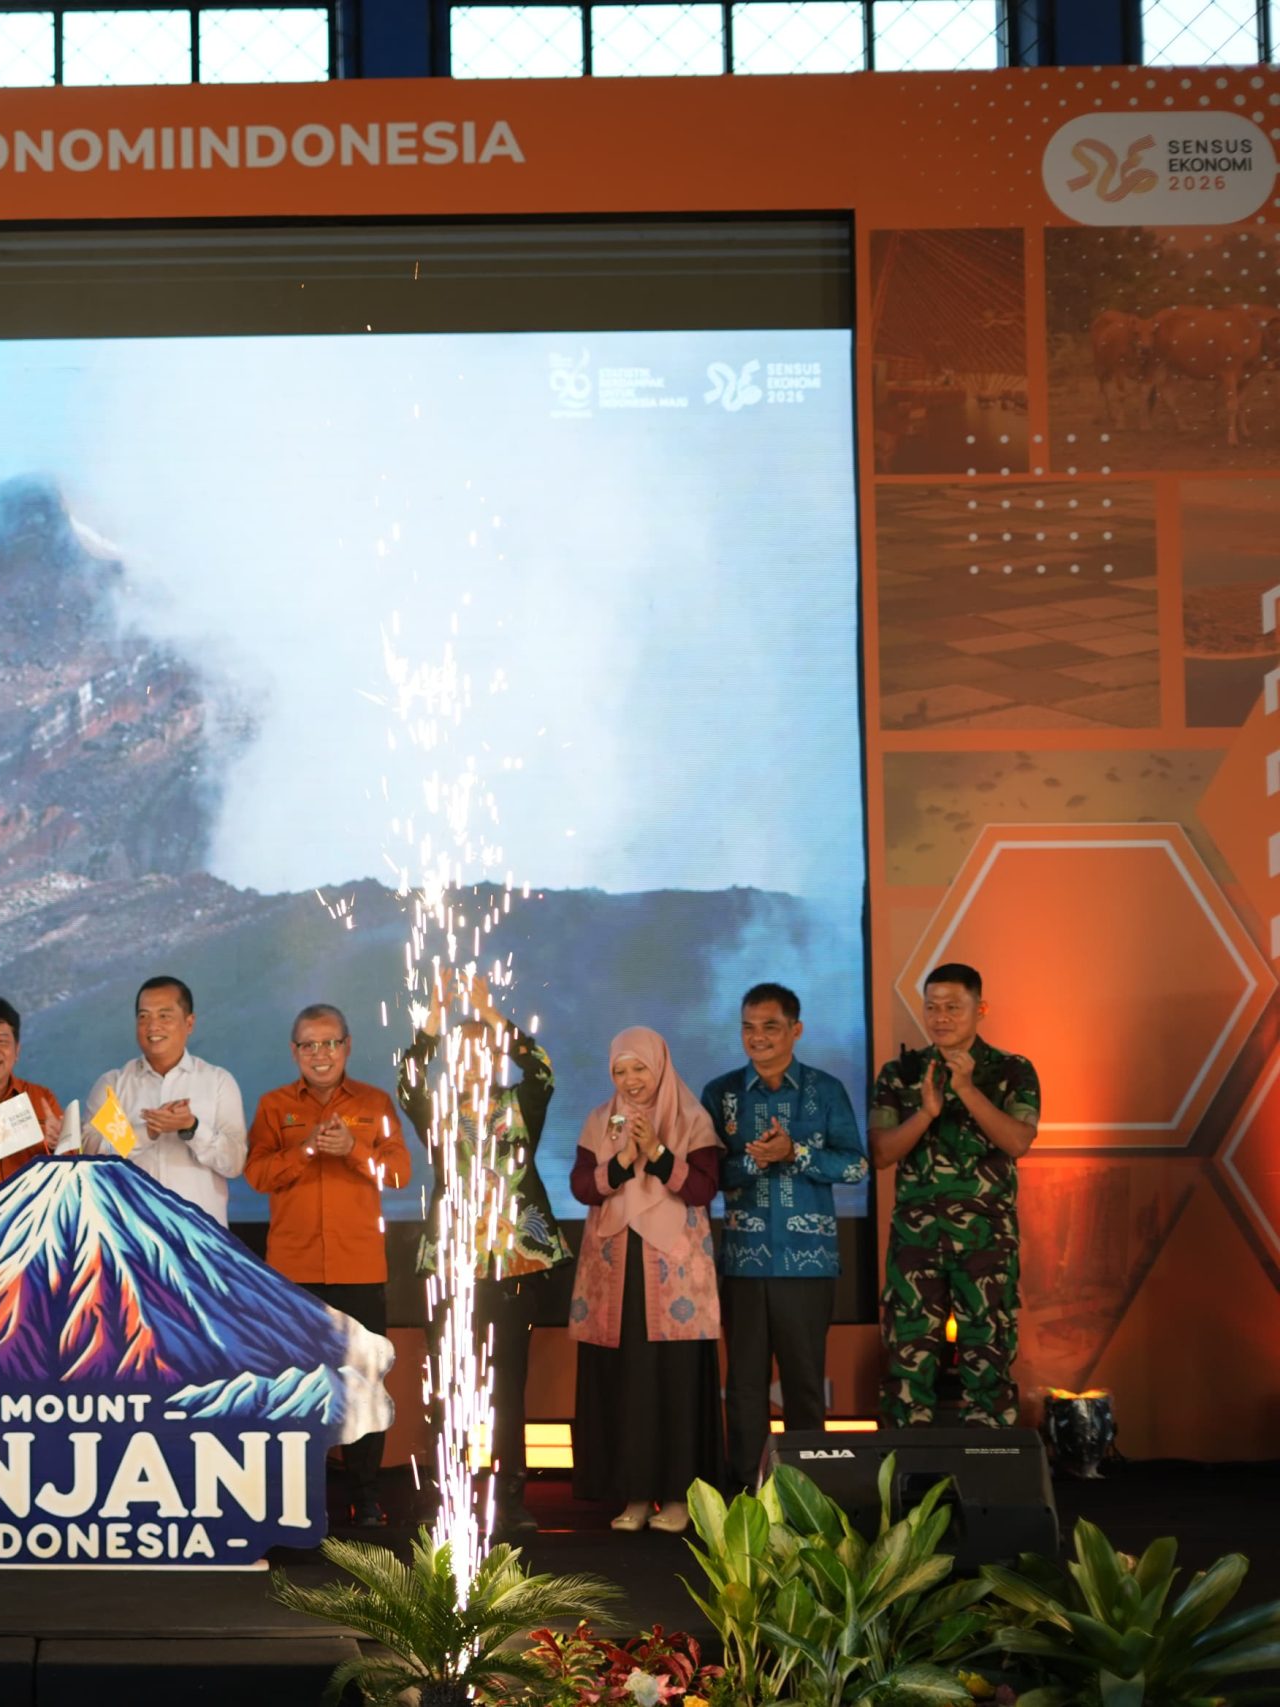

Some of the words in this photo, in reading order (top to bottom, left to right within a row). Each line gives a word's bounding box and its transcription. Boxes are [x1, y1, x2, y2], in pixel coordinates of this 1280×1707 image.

[1168, 139, 1253, 154] SENSUS
[1168, 157, 1253, 172] EKONOMI
[1168, 176, 1226, 190] 2026
[766, 362, 822, 376] SENSUS
[766, 390, 805, 403] 2026
[0, 1394, 151, 1423] MOUNT
[800, 1449, 855, 1460] BAJA
